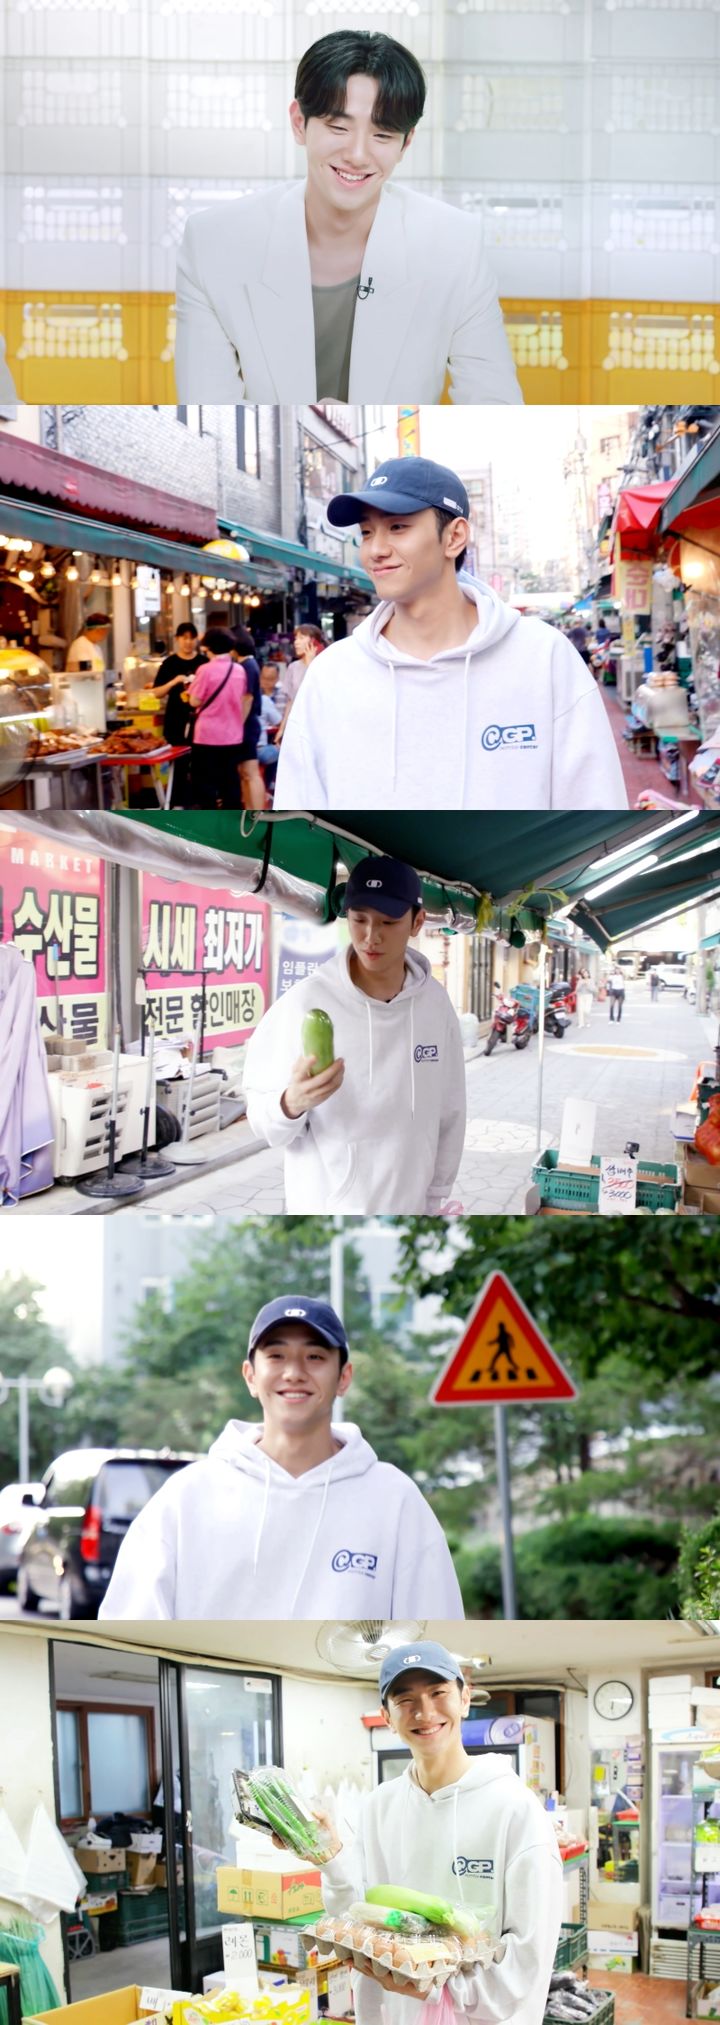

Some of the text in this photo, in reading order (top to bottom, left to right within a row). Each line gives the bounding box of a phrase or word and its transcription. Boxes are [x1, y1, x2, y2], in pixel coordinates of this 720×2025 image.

[11, 848, 93, 874] MARKET
[13, 888, 99, 979] 수산물
[143, 902, 263, 976] 시세 최저가
[145, 989, 255, 1036] 전문 할인매장
